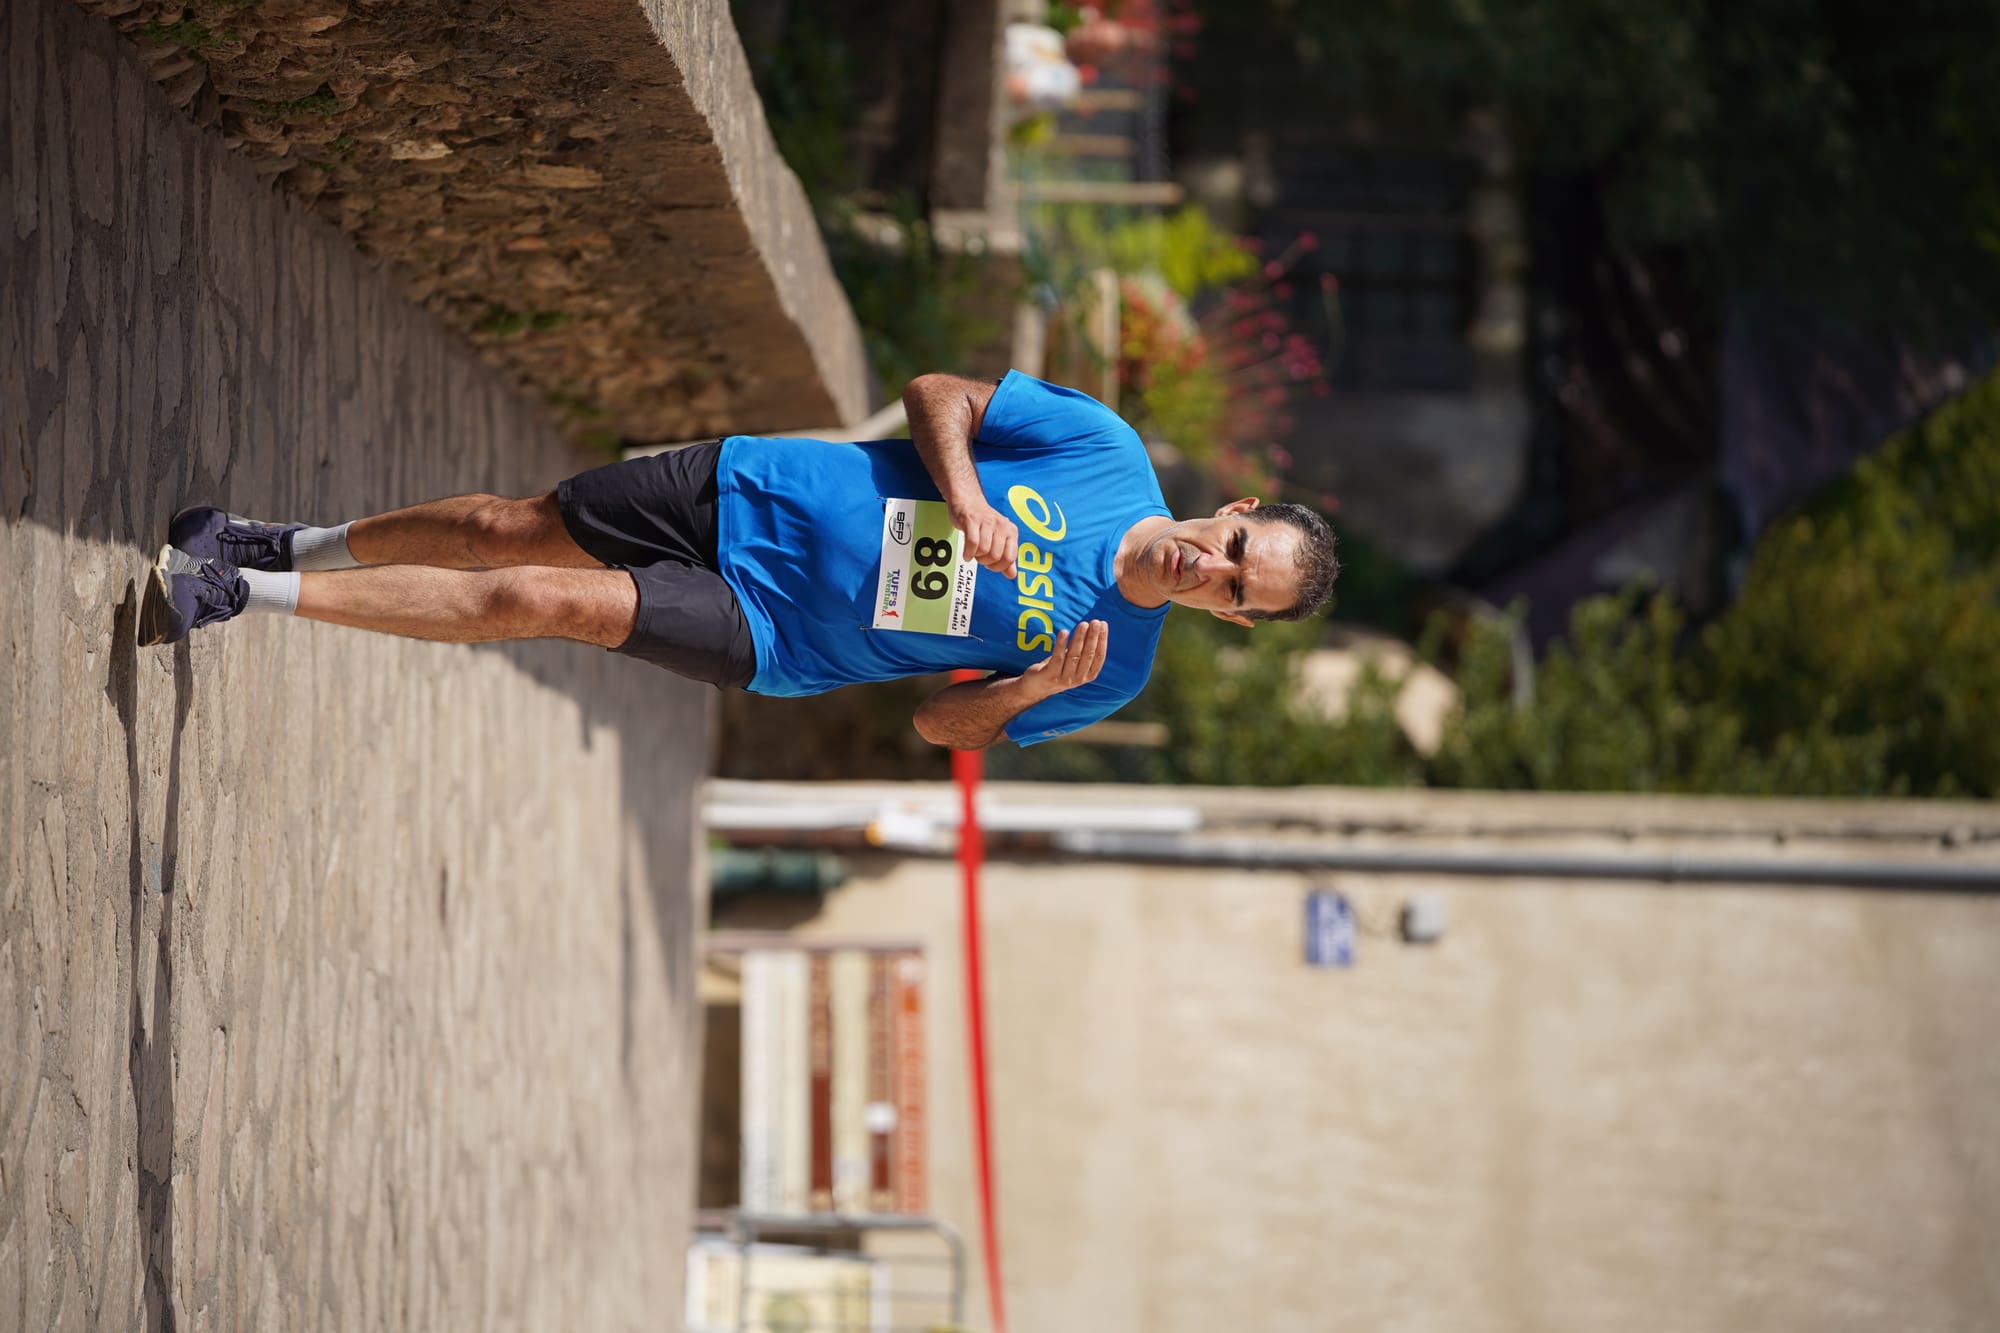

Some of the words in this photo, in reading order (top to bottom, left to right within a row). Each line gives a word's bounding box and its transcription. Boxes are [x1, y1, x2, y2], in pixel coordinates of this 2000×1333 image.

[895, 511, 906, 540] BFP
[911, 537, 952, 600] 89
[882, 572, 894, 610] Aventure
[888, 569, 901, 607] TUFF'S
[961, 569, 974, 611] Challenge
[1017, 543, 1054, 651] asics
[960, 614, 968, 628] des
